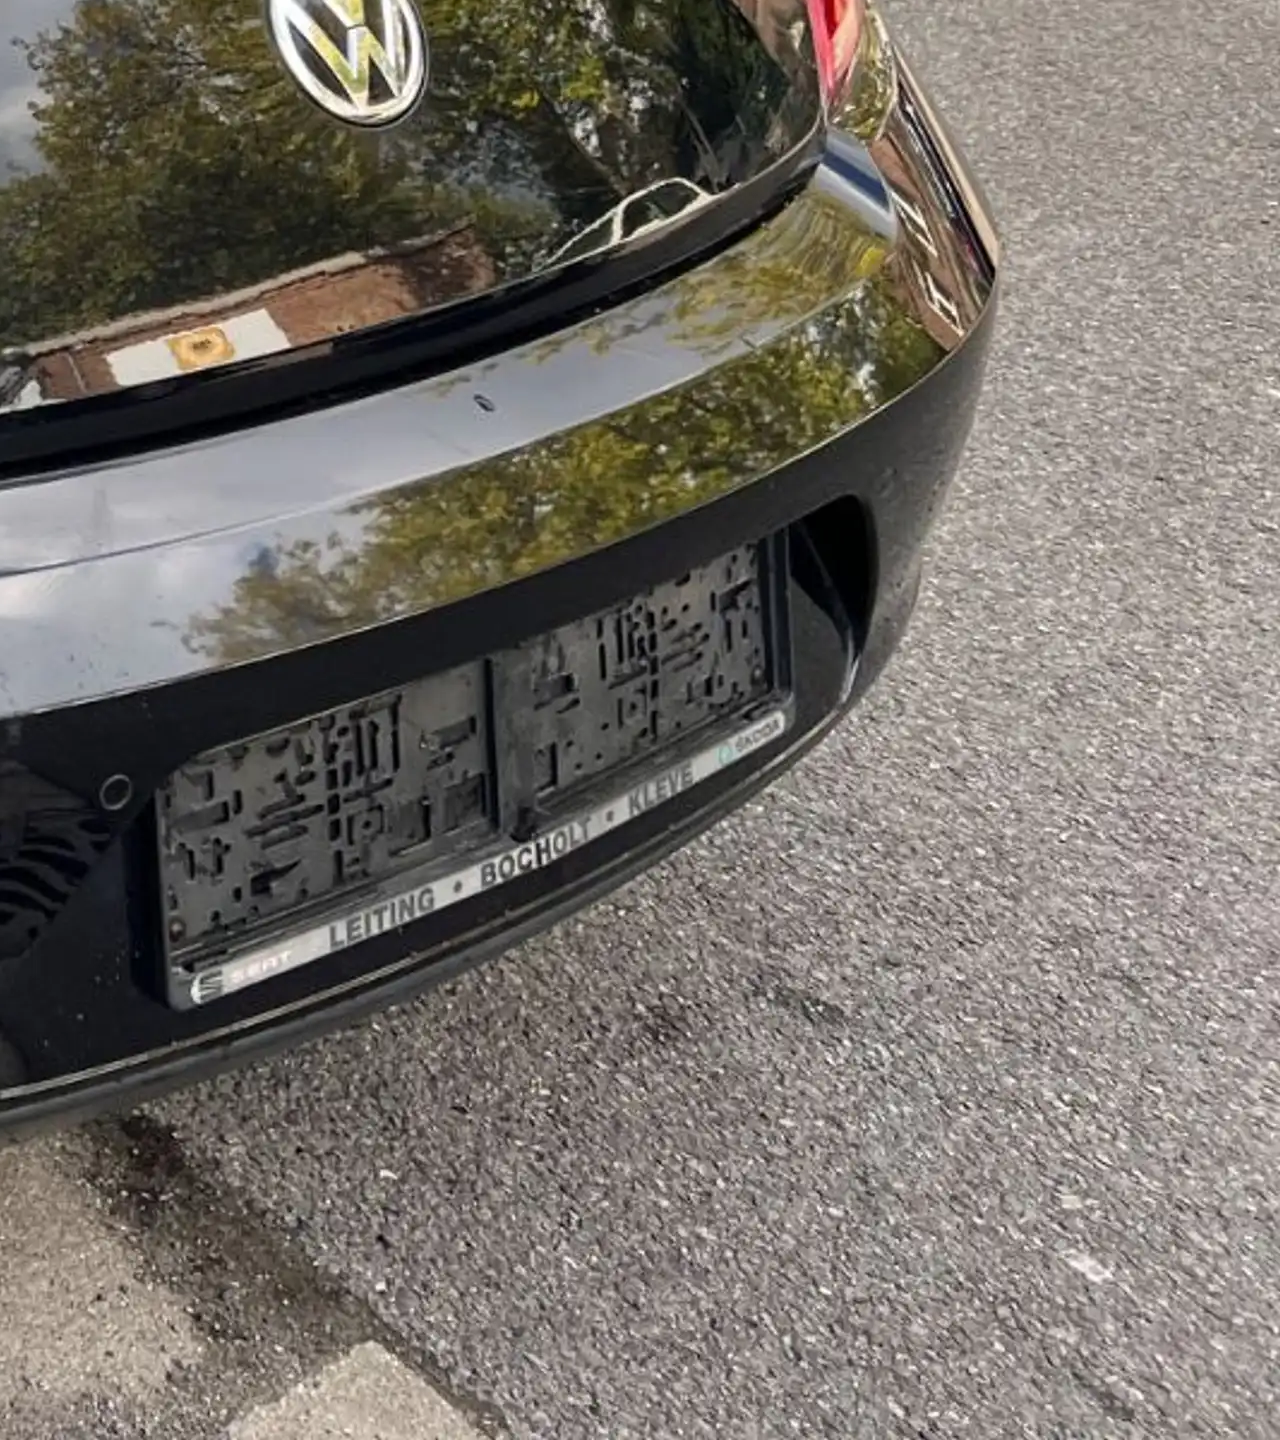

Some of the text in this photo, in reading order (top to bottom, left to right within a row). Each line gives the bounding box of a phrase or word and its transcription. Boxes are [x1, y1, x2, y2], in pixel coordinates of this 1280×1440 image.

[329, 888, 435, 949] LEITING
[481, 816, 592, 888] BOCHOLT
[628, 759, 694, 816] KLEVE
